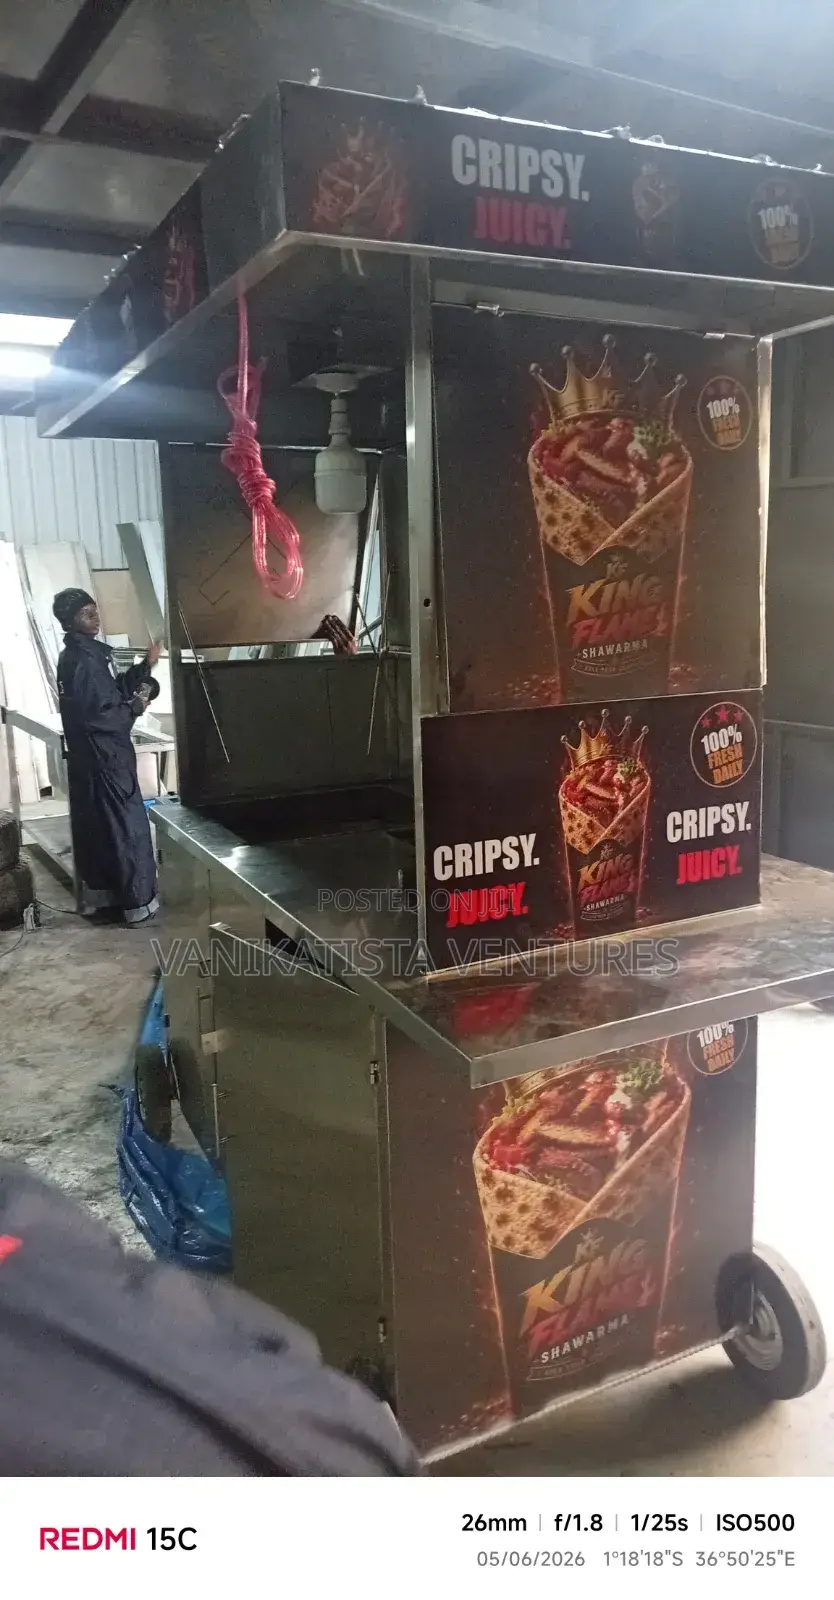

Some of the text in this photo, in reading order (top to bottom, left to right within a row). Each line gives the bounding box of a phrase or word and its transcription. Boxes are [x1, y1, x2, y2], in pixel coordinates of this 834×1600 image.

[451, 134, 590, 202] CRIPSY.
[474, 196, 572, 249] JUICY.
[758, 204, 799, 230] 100%
[706, 396, 741, 419] 100%
[565, 573, 664, 627] KING
[581, 639, 649, 659] SHAWARMA
[700, 724, 743, 755] 100%
[707, 742, 743, 770] FRESH
[712, 759, 744, 785] DAILY
[667, 801, 752, 843] CRIPSY.
[433, 833, 540, 881] CRIPSY.
[577, 853, 633, 893] KING
[676, 844, 743, 885] JUICY.
[446, 881, 529, 928] JUICY.
[586, 894, 625, 911] SHAWARMA
[696, 1021, 735, 1048] 100%
[519, 1238, 648, 1337] KING
[541, 1313, 630, 1364] SHAWARMA
